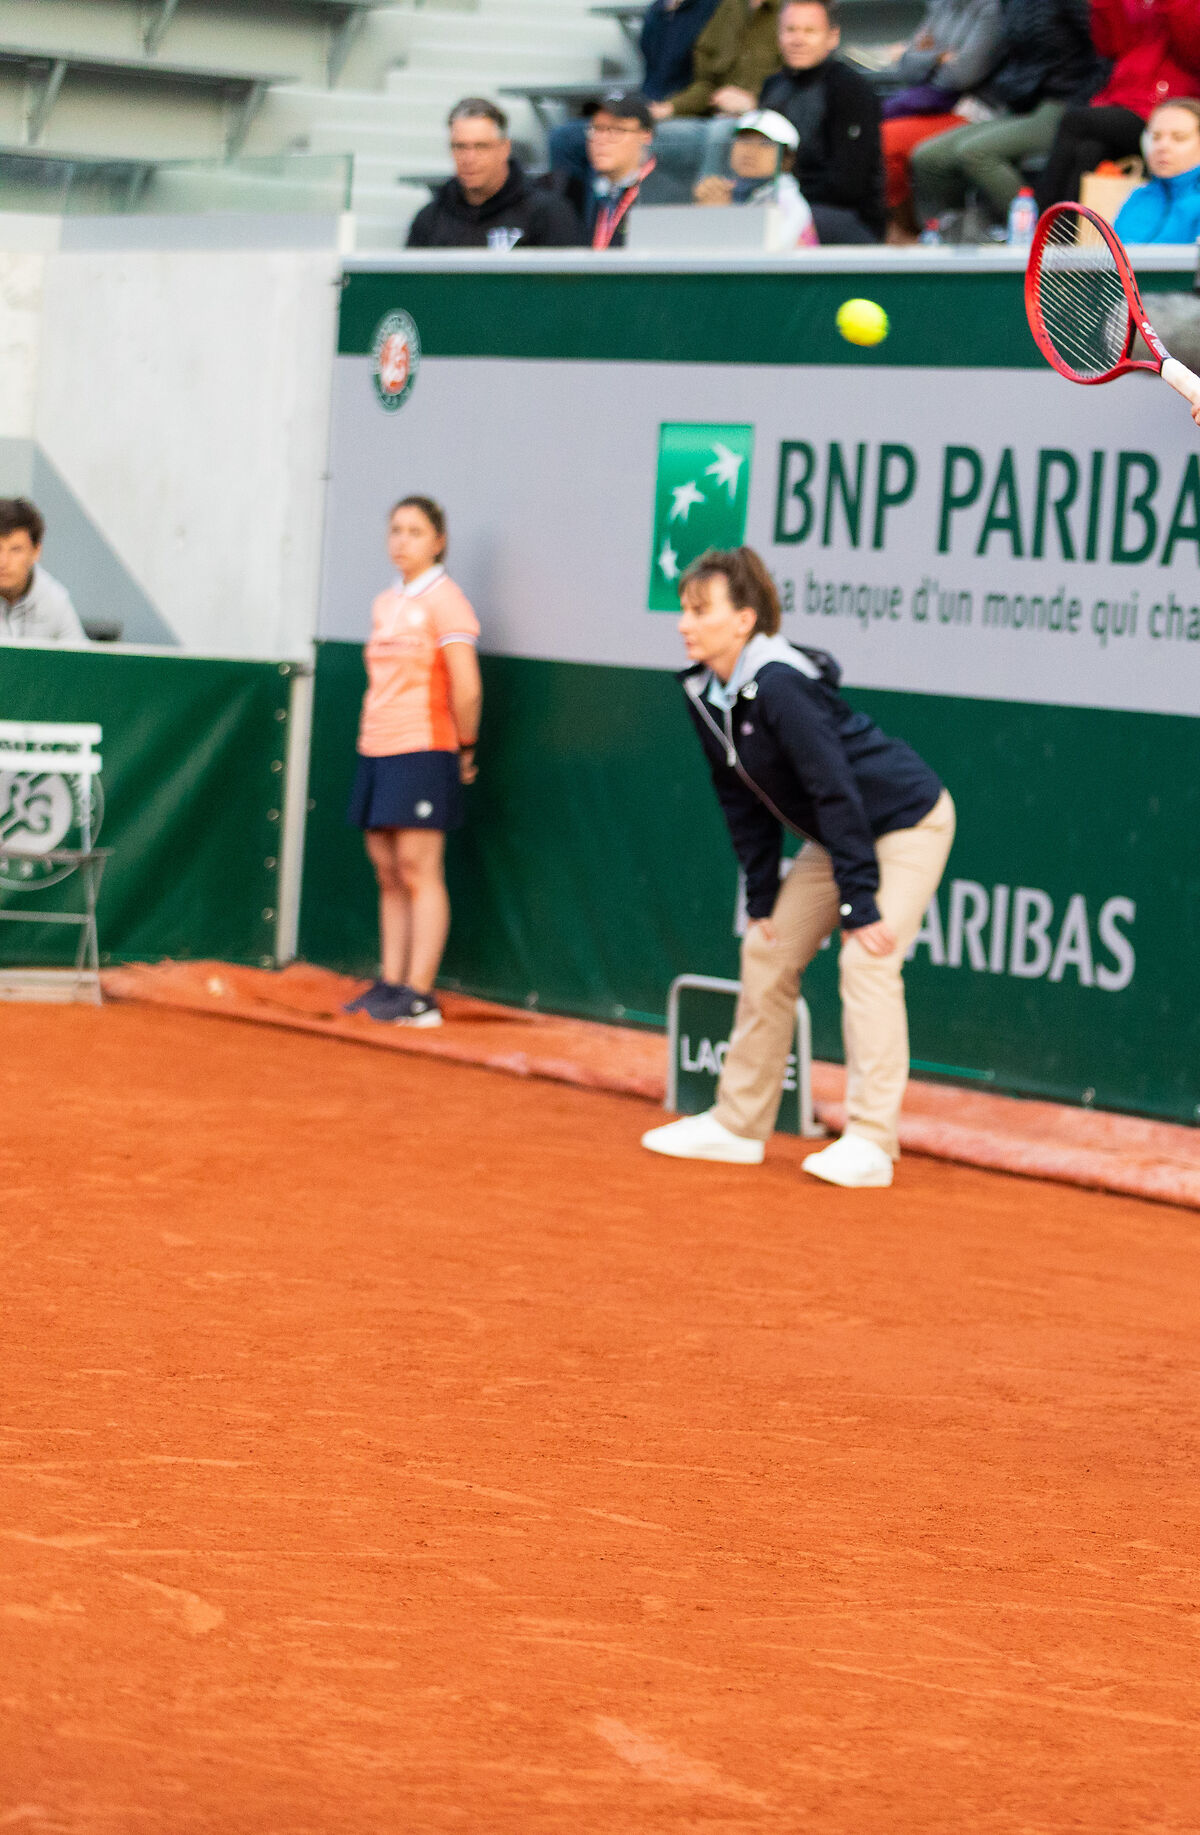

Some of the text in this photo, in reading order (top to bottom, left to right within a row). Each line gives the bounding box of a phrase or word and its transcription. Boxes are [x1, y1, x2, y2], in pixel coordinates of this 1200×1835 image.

[773, 438, 916, 550] BNP
[803, 568, 902, 630] banque
[911, 576, 972, 626] d'un
[982, 585, 1081, 633] monde
[1092, 589, 1139, 648] qui
[903, 878, 1136, 992] ARIBAS
